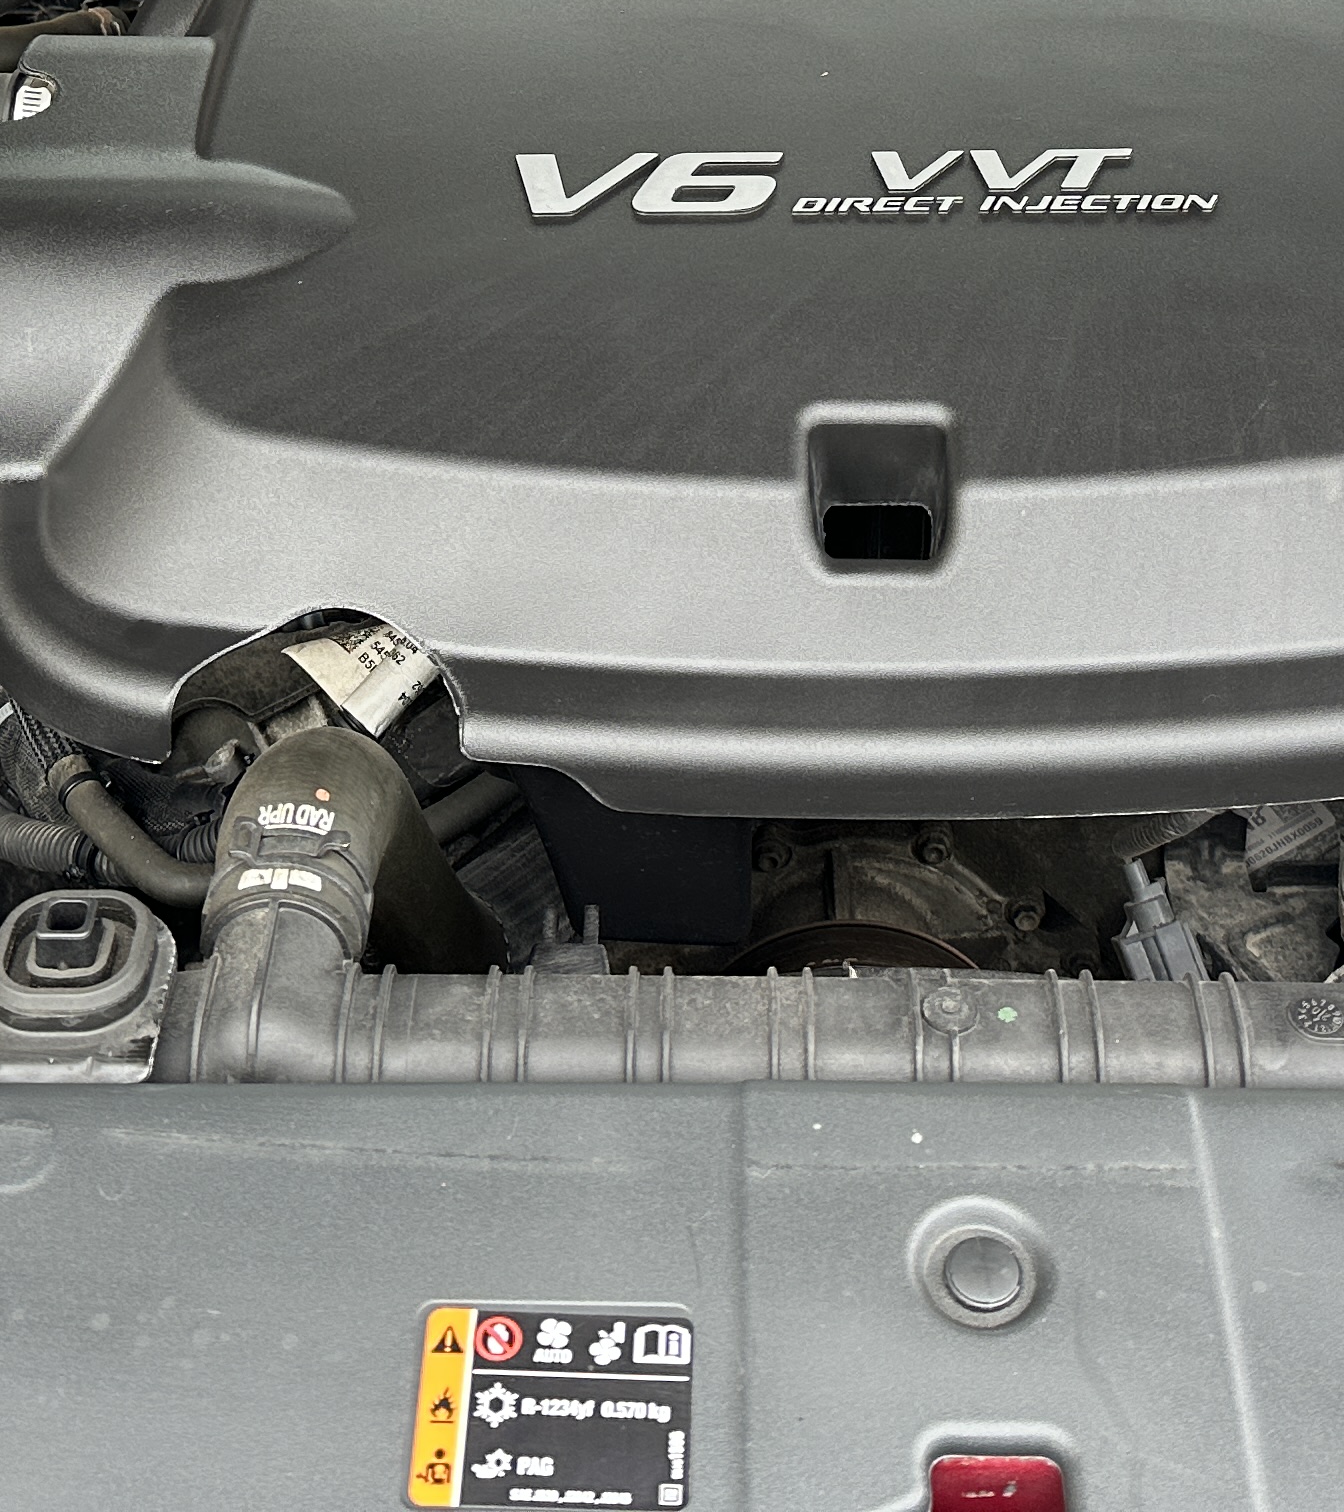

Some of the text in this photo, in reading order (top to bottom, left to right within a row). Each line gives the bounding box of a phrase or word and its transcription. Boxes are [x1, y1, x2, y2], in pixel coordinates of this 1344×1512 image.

[514, 150, 785, 218] V6
[870, 147, 1134, 194] VVT
[790, 192, 1220, 216] DIRECT INJECTION
[257, 802, 336, 832] RAD UPR
[532, 1348, 574, 1364] AUTO
[520, 1397, 672, 1424] R-1234yf 0.570 kg
[515, 1455, 555, 1477] PAG
